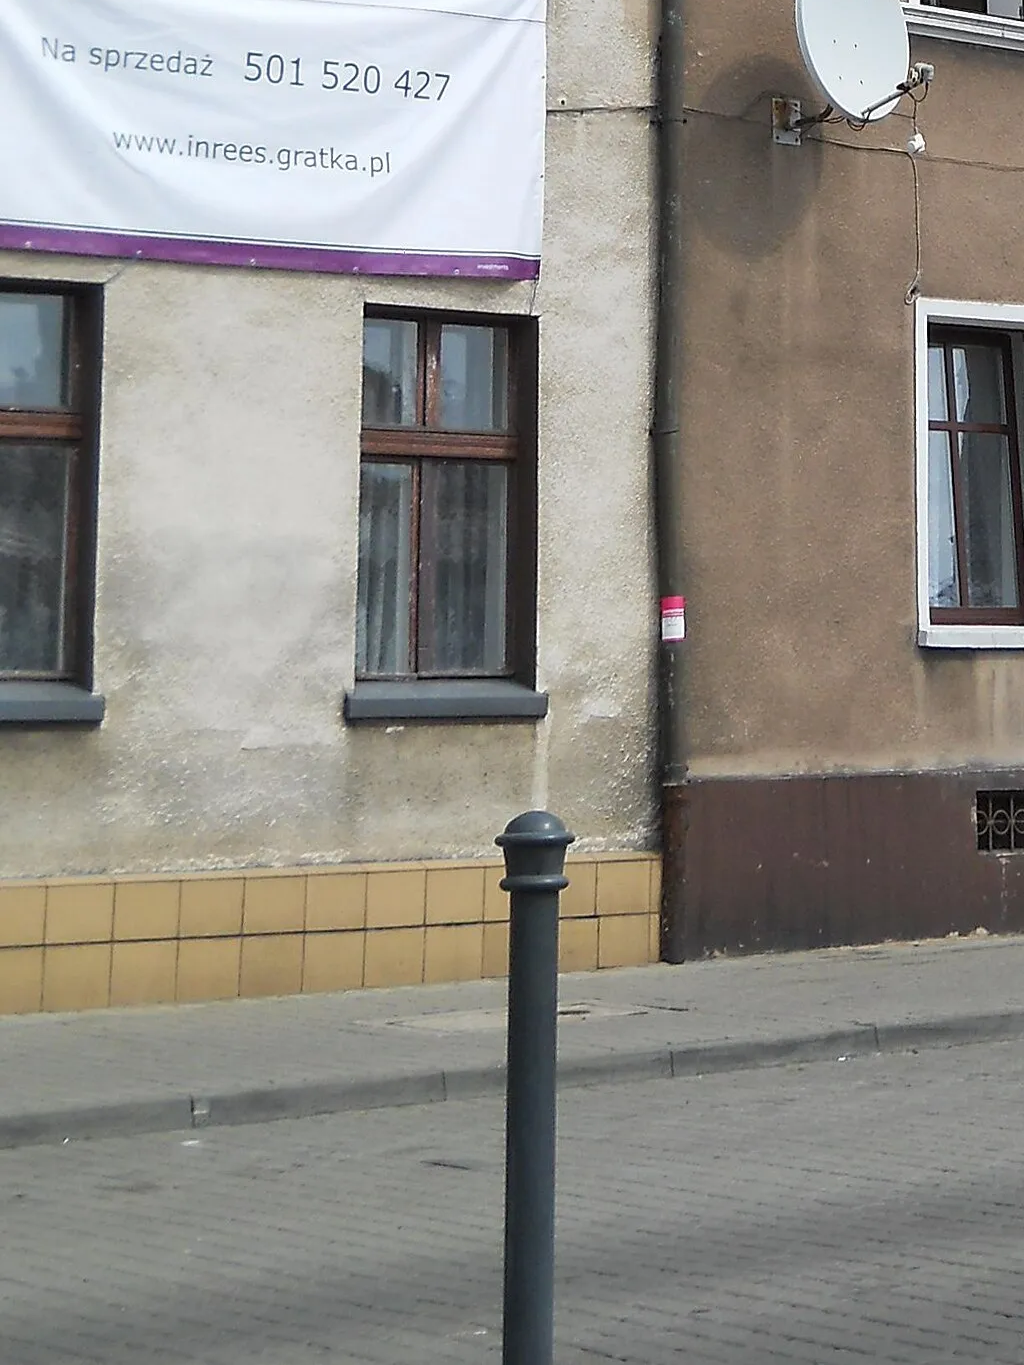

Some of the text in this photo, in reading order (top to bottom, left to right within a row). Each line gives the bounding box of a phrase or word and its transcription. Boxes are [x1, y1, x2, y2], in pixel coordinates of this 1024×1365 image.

[41, 36, 450, 101] Na sprzedaż 501 520 427
[112, 131, 391, 177] www.inrees.gratka.pl
